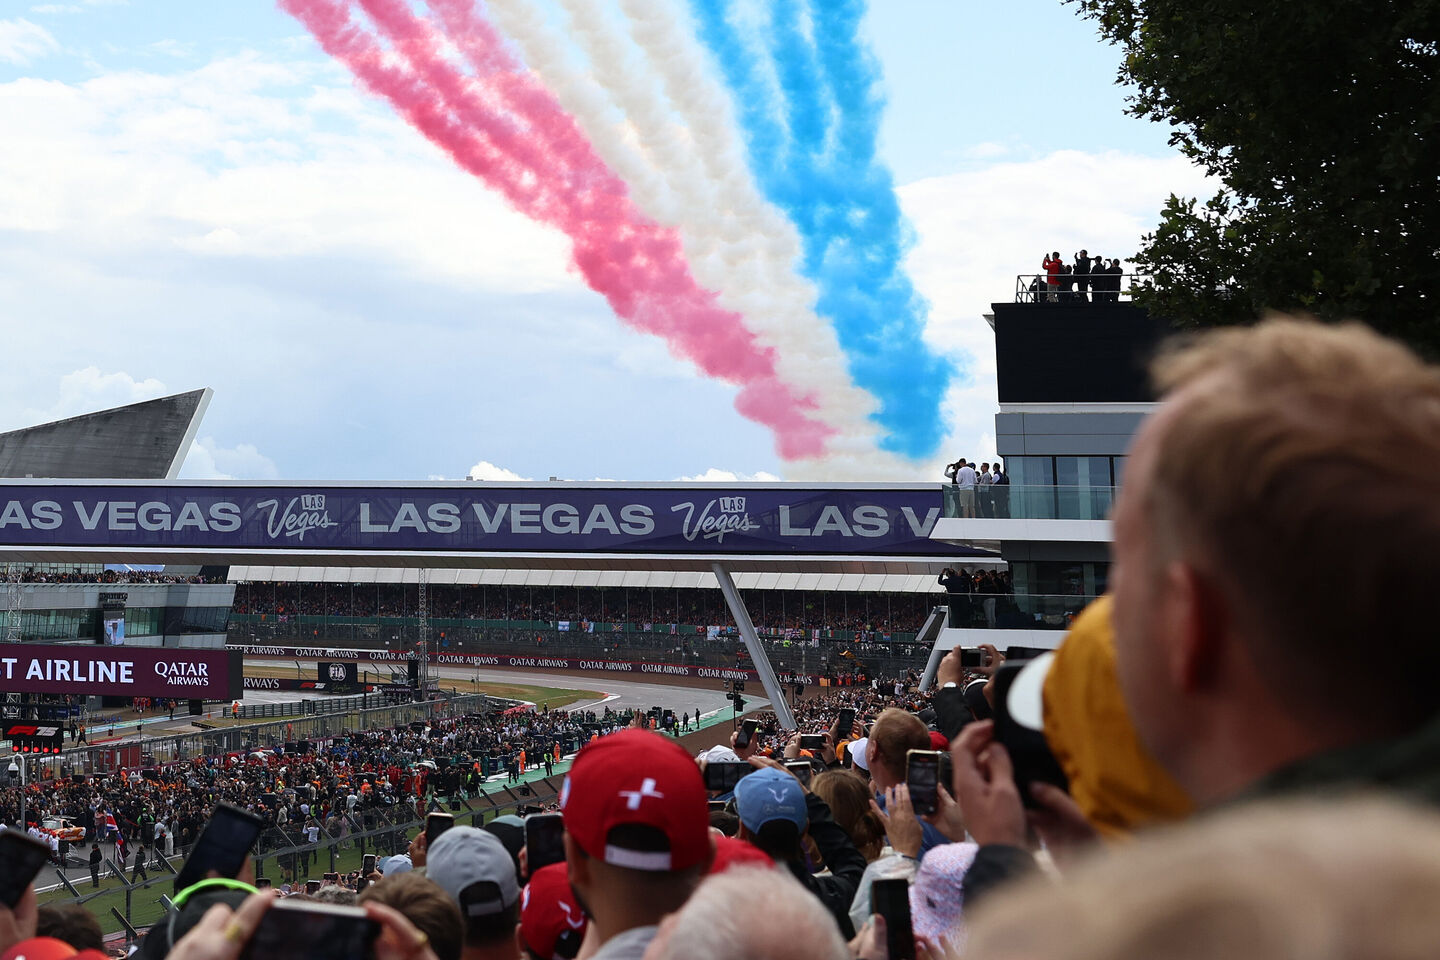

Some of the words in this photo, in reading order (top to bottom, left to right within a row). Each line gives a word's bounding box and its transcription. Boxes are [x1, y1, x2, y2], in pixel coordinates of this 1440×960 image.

[303, 496, 324, 509] LAS
[720, 498, 745, 512] LAS
[72, 501, 242, 532] VEGAS
[257, 497, 338, 541] Vegas
[360, 503, 461, 534] LAS
[472, 503, 656, 536] VEGAS
[671, 499, 761, 544] Vegas
[779, 505, 890, 538] LAS
[250, 646, 285, 655] AIRWAYS
[295, 648, 323, 657] QATAR
[369, 652, 396, 661] QATAR
[438, 654, 464, 664] QATAR
[465, 656, 499, 665] AIRWAYS
[509, 657, 535, 667] QATAR
[536, 659, 569, 668] AIRWAYS
[579, 660, 604, 670] QATAR
[604, 662, 632, 671] AIRWAYS
[25, 659, 134, 683] AIRLINE
[154, 661, 209, 678] QATAR
[641, 663, 662, 673] QATAR
[662, 665, 689, 676] AIRWAYS
[698, 667, 720, 678] QATAR
[720, 669, 749, 680] AIRWAYS
[167, 675, 210, 686] AIRWAYS
[243, 677, 280, 689] RWAYS
